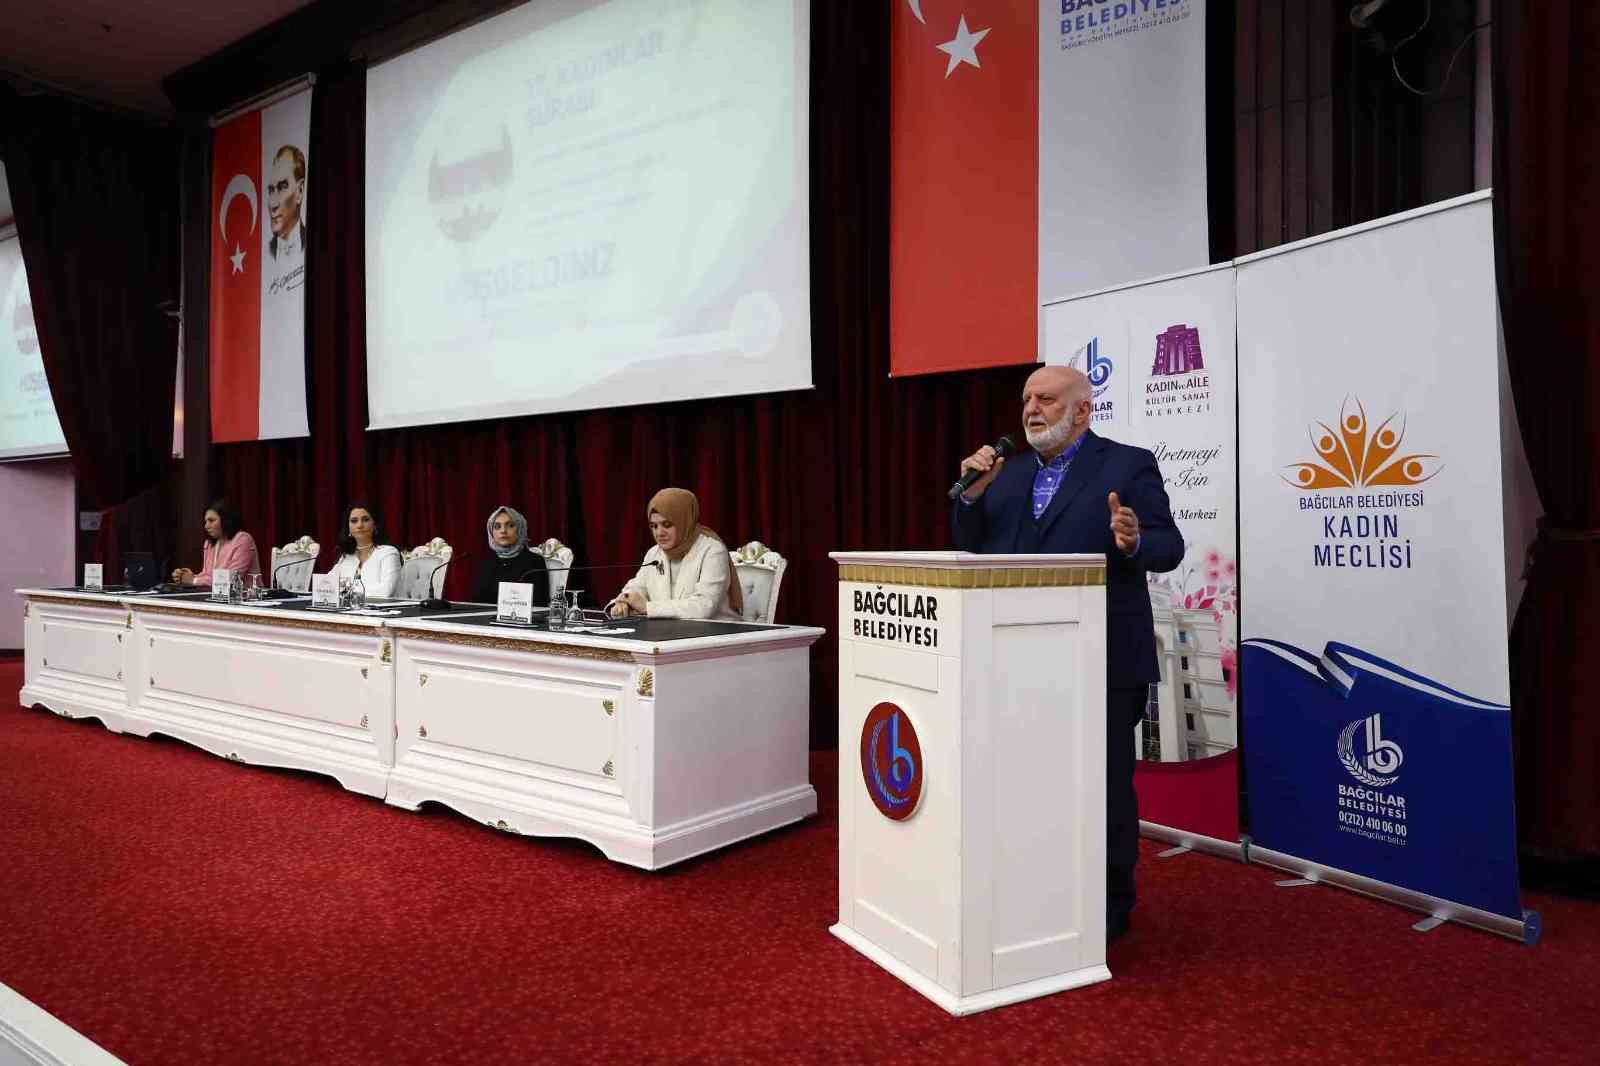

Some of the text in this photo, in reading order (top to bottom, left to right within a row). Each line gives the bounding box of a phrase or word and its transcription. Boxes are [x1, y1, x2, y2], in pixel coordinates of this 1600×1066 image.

[1146, 379, 1178, 394] KADIN
[1186, 374, 1209, 389] AİLE
[1299, 490, 1424, 510] BAĞCILAR BELEDİYESİ
[1178, 507, 1218, 520] Merkezi
[1324, 514, 1398, 538] KADIN
[1314, 539, 1412, 569] MECLİSİ
[854, 585, 938, 621] BAĞCILAR
[1338, 783, 1406, 809] BAĞCILAR
[1338, 797, 1407, 820] BELEDİYESİ
[1338, 810, 1407, 837] 0(212) 410 06 00
